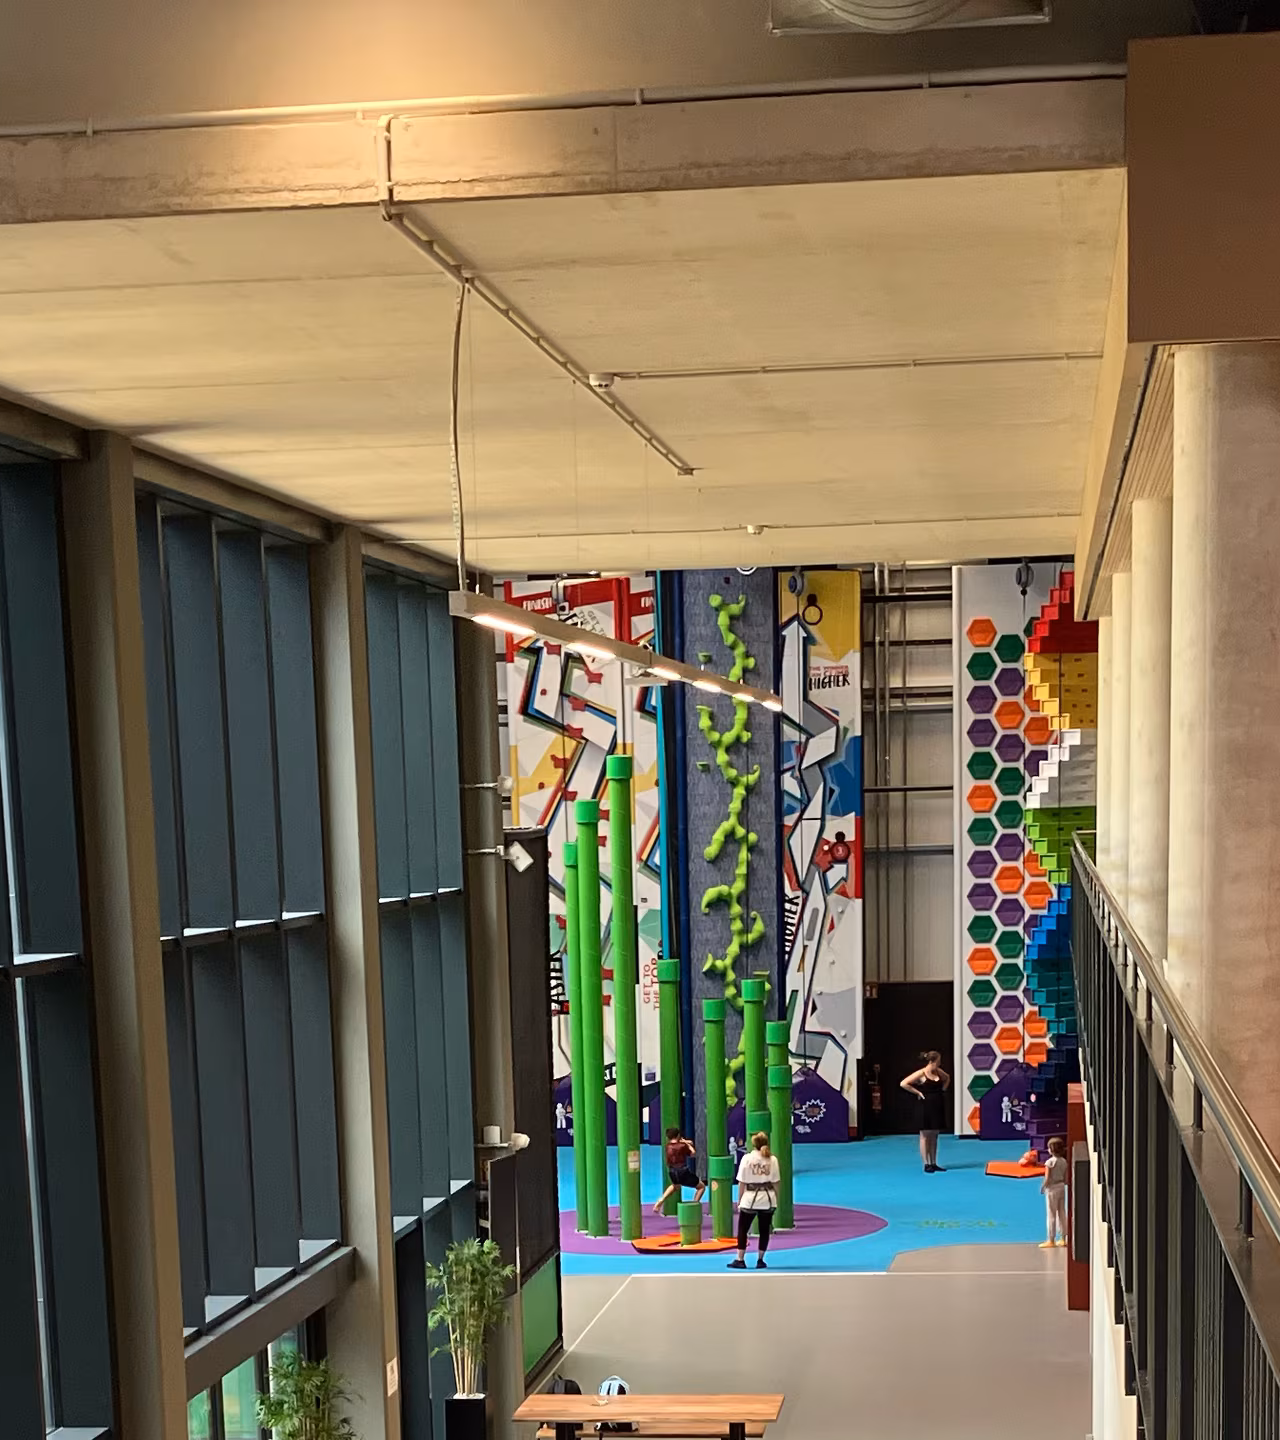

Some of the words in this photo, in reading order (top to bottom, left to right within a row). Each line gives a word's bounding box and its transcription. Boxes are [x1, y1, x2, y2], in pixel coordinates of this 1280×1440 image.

[808, 674, 851, 691] HIGHER
[643, 964, 651, 979] TO
[643, 983, 651, 1004] GET
